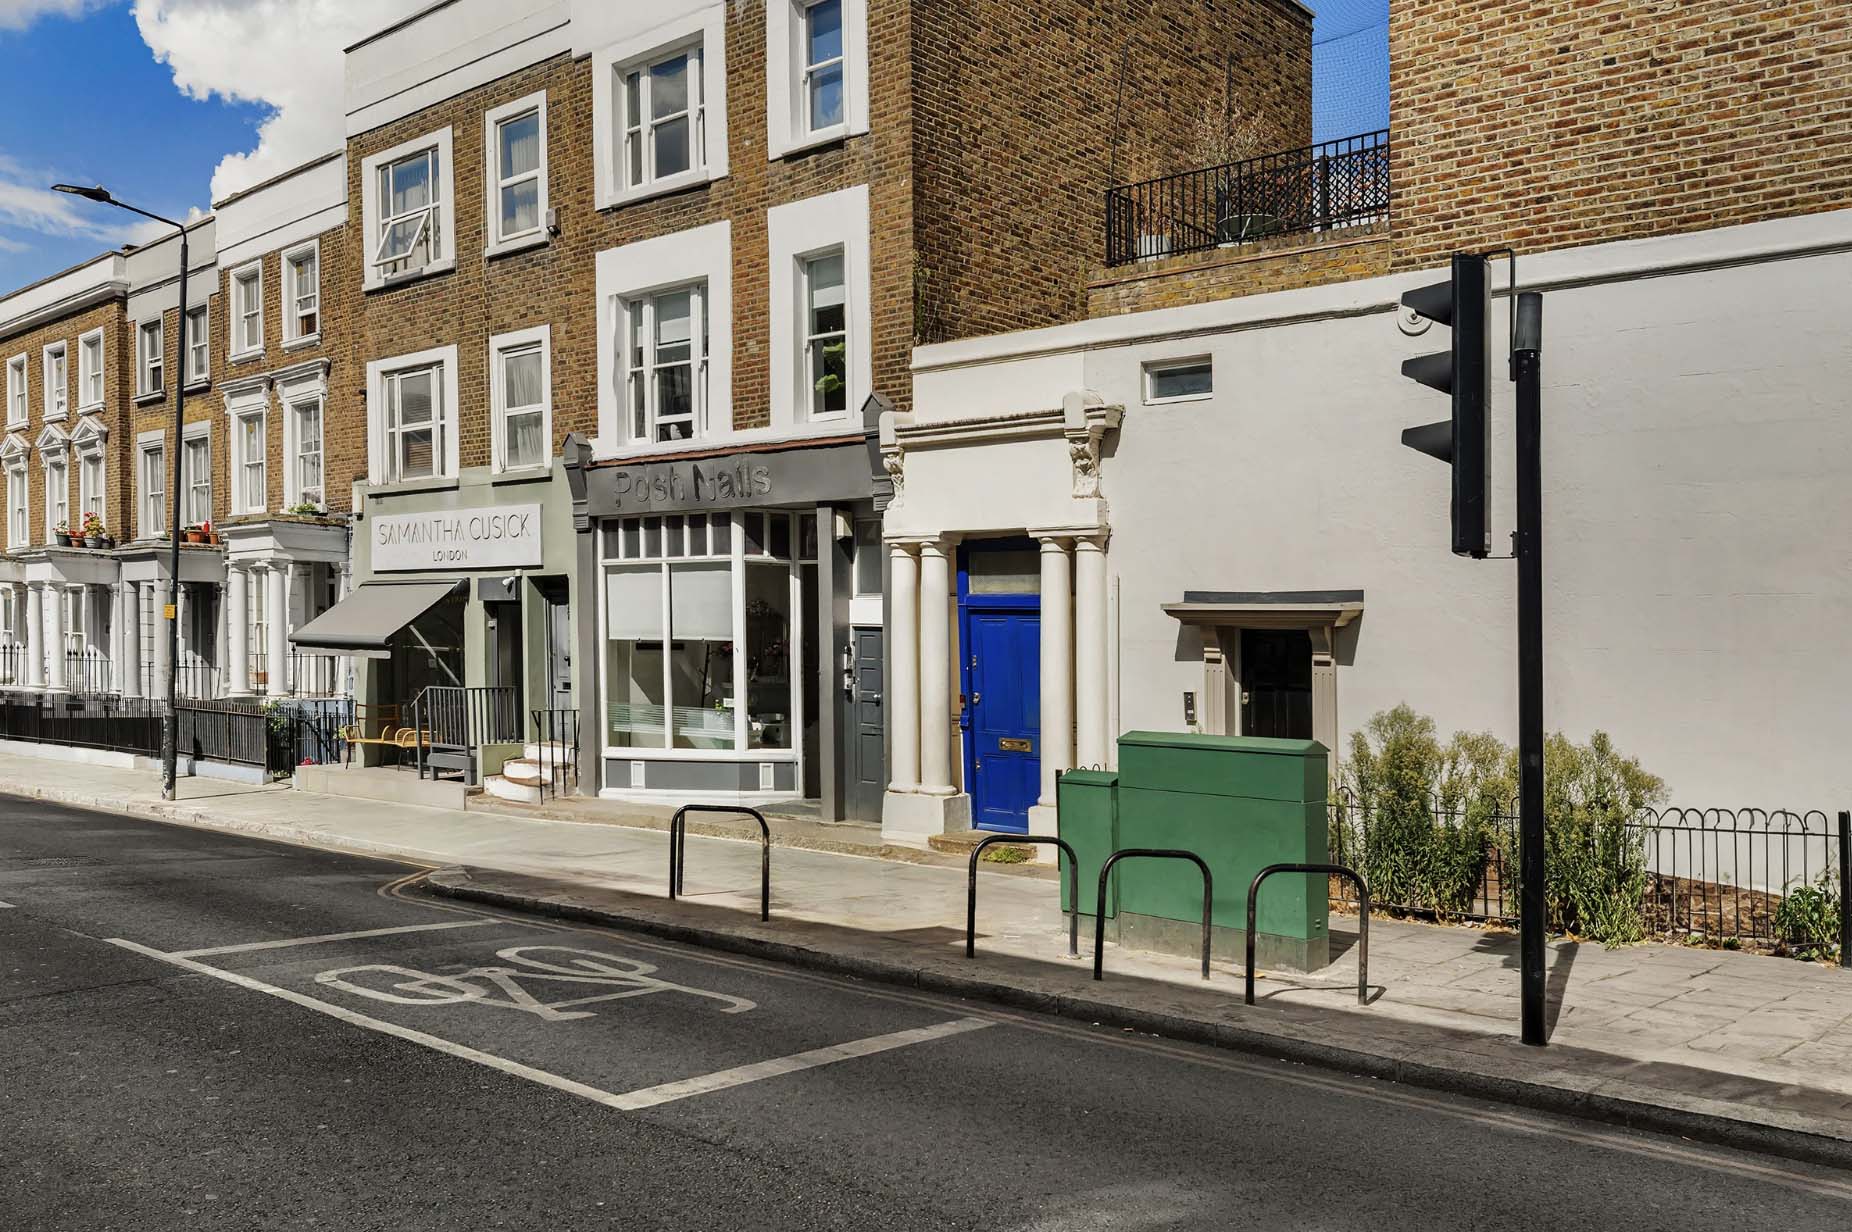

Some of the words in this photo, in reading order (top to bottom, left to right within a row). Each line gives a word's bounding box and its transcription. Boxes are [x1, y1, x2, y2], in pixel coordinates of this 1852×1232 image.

[615, 464, 685, 507] Posh
[692, 454, 772, 501] Nails
[378, 518, 465, 546] SAMANTHA
[469, 512, 531, 541] CUSICK
[432, 550, 468, 562] LONDON
